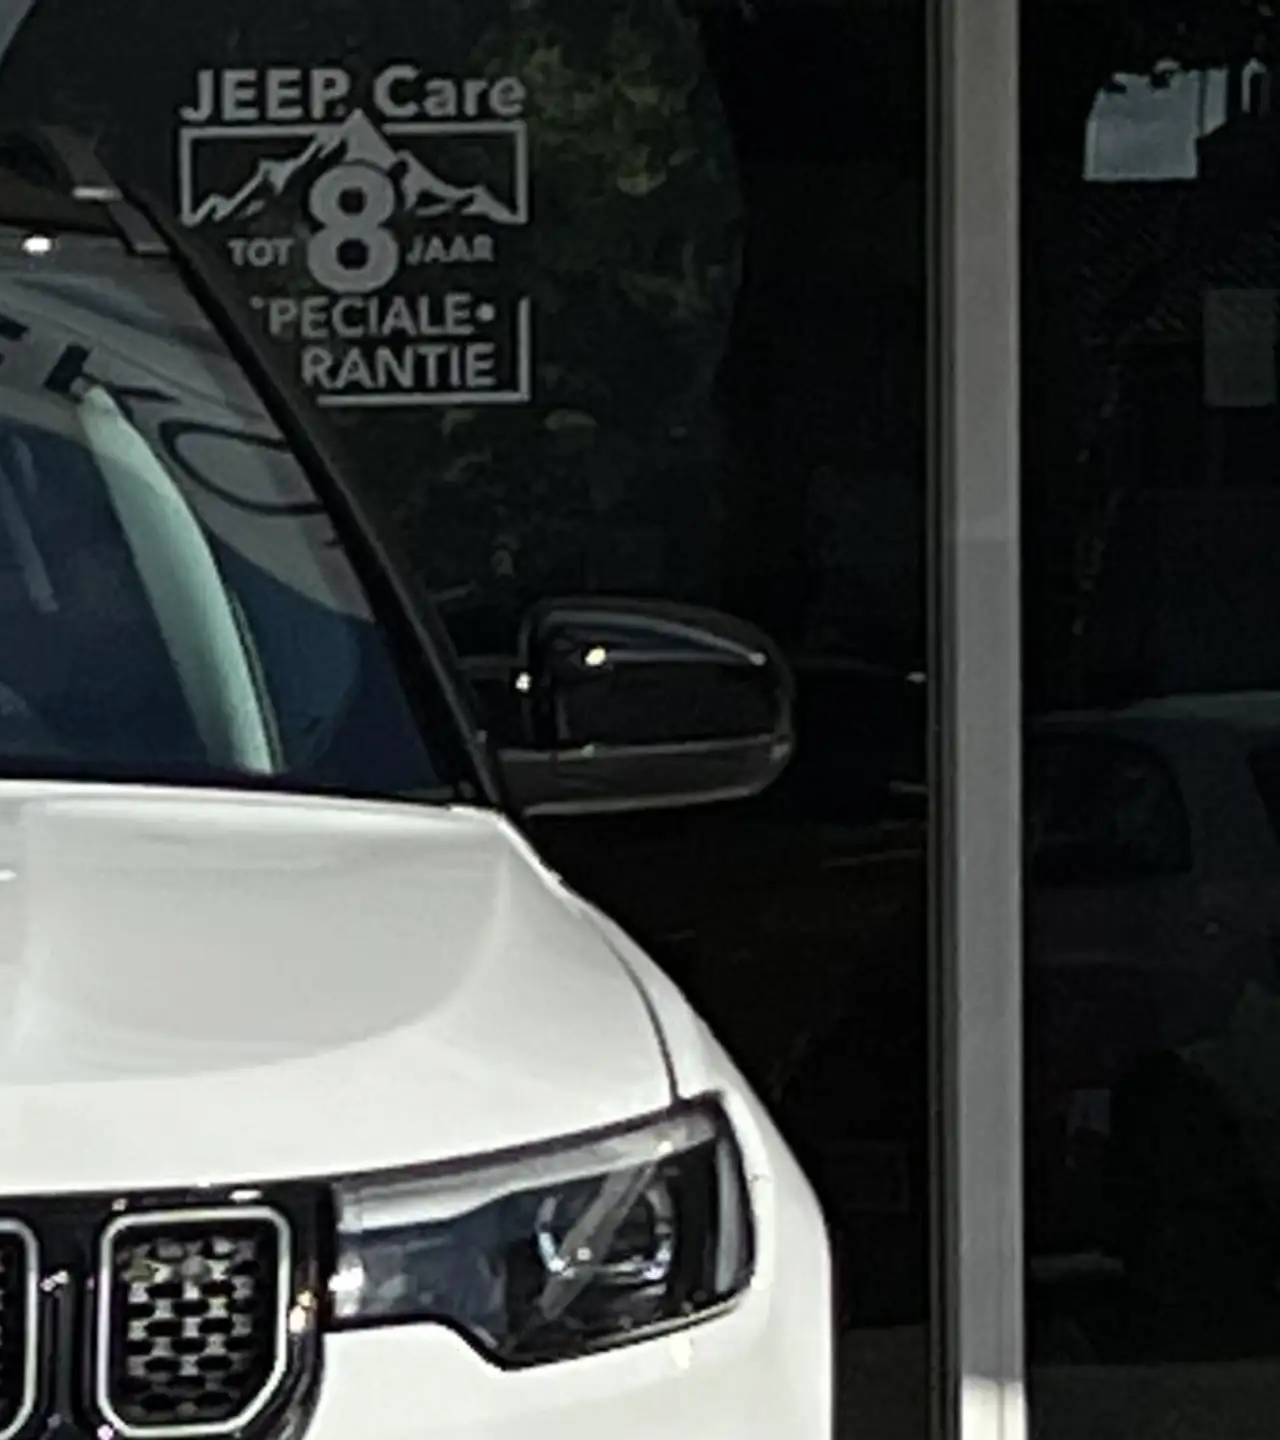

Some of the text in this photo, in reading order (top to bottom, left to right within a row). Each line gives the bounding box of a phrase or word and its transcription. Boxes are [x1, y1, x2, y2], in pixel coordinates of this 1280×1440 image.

[179, 62, 529, 122] JEEP Care
[226, 161, 497, 295] TOT 8 JAAR
[249, 291, 476, 338] PECIALE
[300, 341, 498, 391] RANTIE
